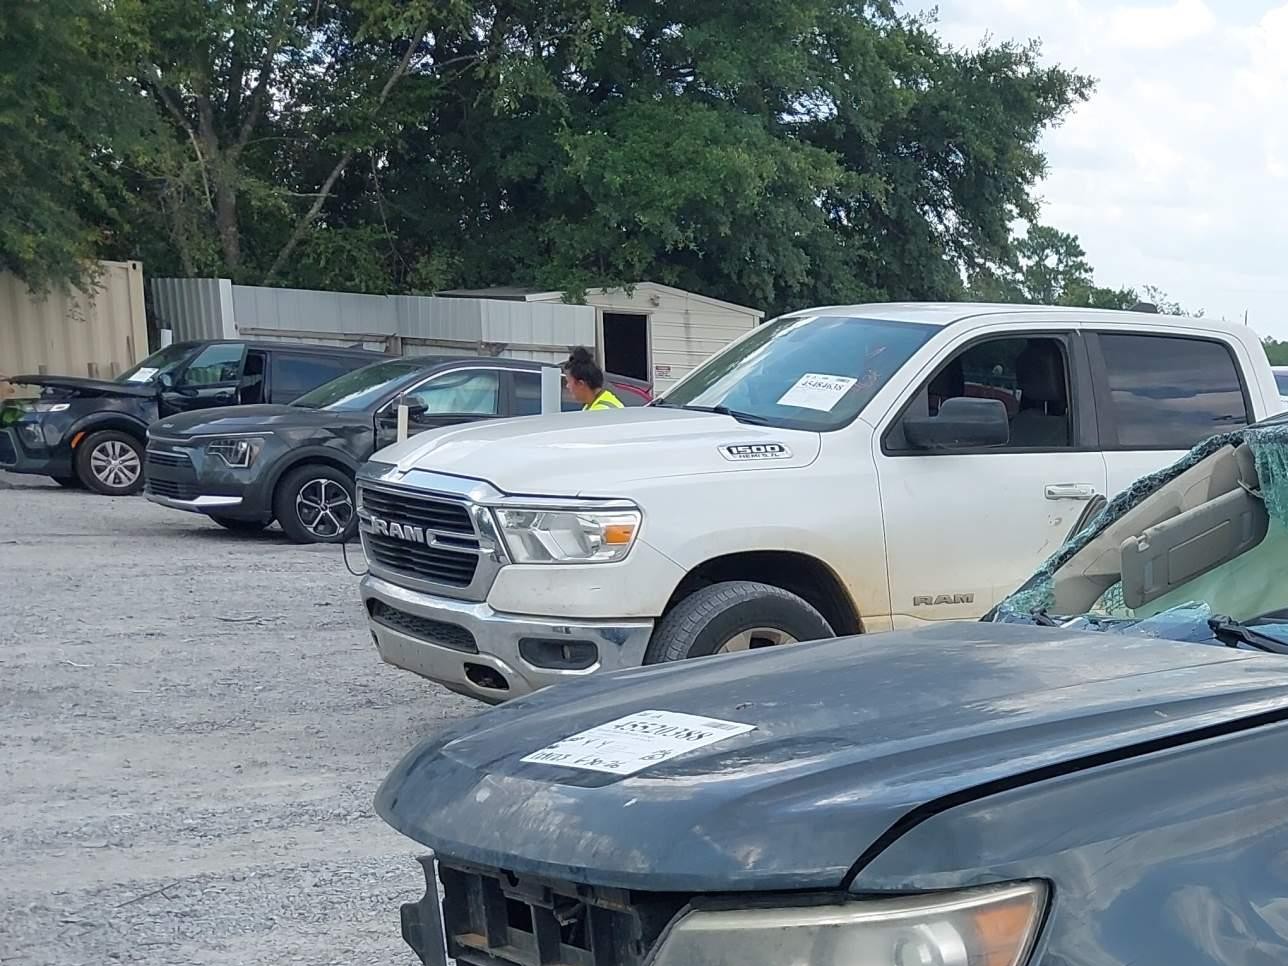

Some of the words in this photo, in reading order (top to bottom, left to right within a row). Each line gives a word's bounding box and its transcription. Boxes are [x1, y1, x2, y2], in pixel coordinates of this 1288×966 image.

[730, 445, 780, 454] 1500
[371, 516, 424, 543] RAM
[912, 592, 975, 607] RAM
